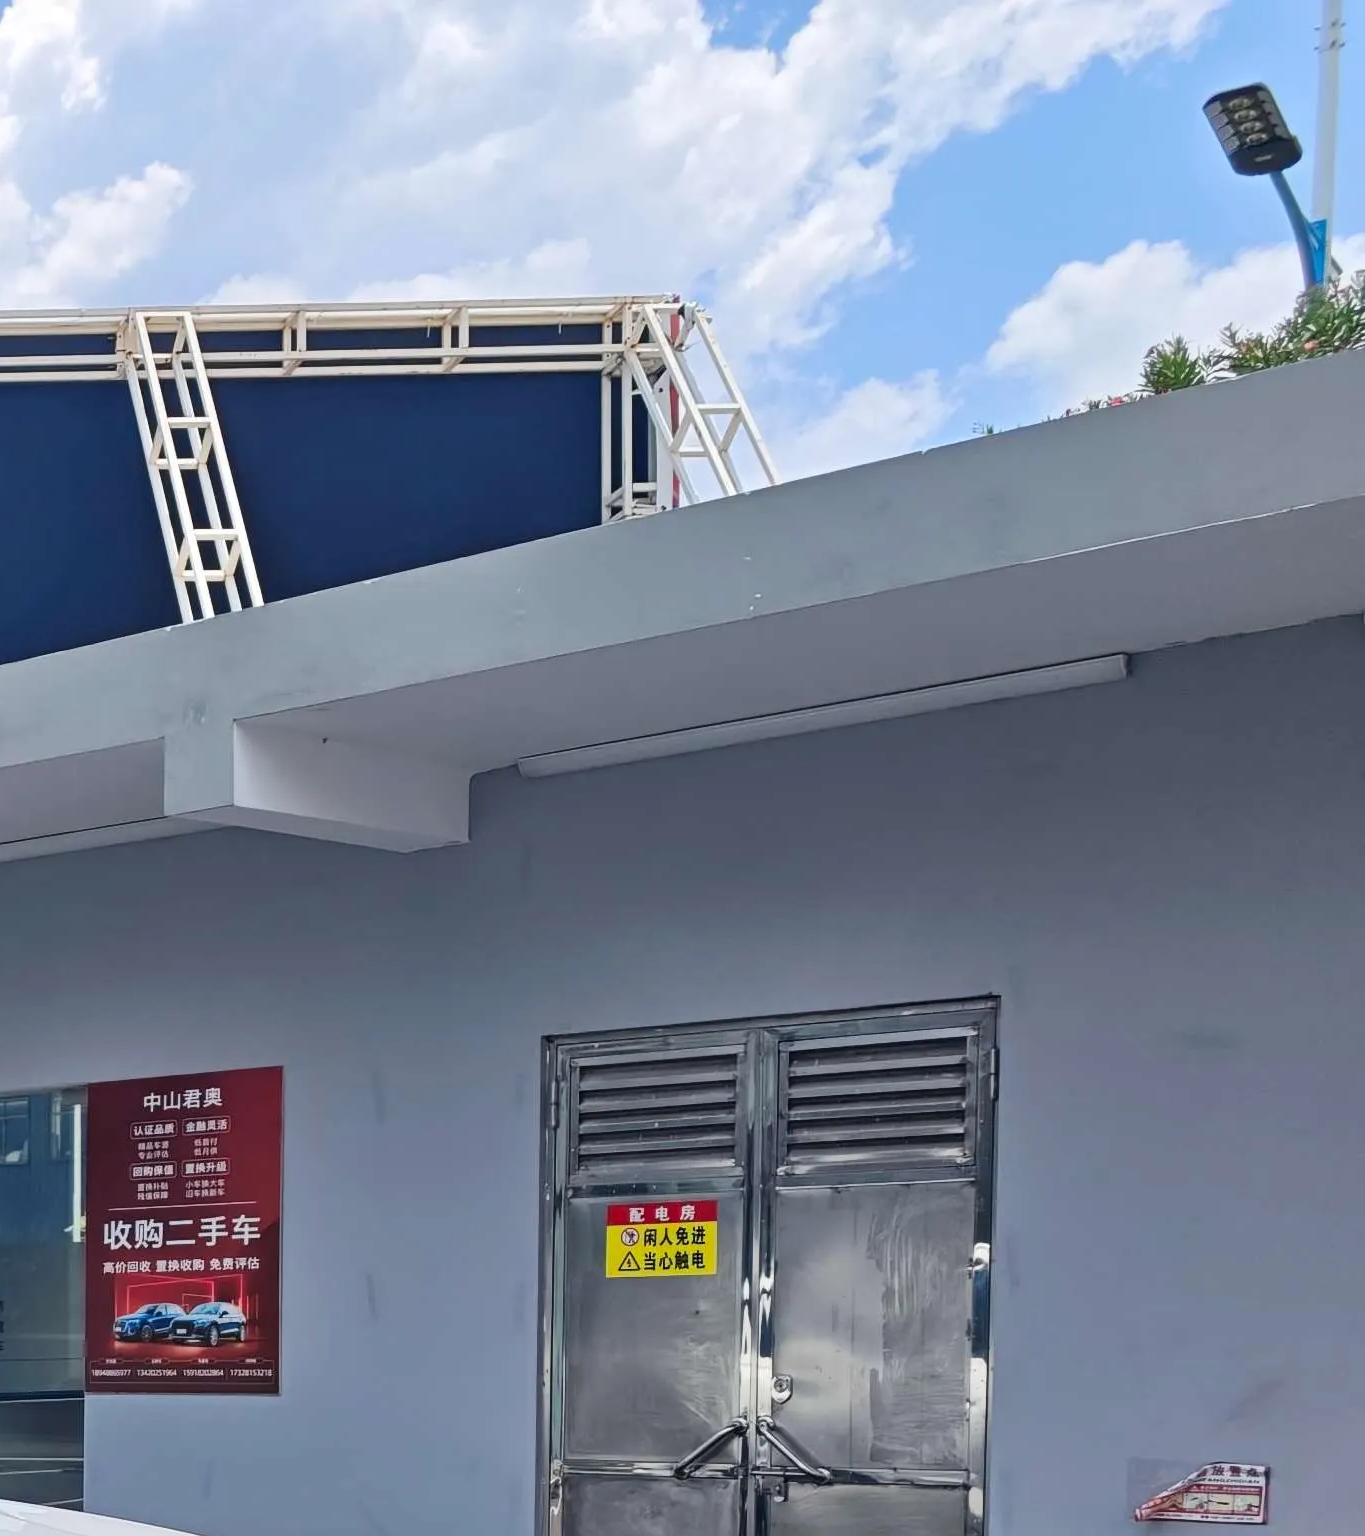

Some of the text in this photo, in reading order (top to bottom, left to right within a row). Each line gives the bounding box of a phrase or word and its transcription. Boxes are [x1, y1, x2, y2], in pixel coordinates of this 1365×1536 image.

[133, 1122, 175, 1136] 认证品质
[185, 1119, 228, 1133] 金融灵活
[185, 1161, 227, 1175] 置换升级
[629, 1205, 696, 1223] 配电房
[103, 1214, 261, 1250] 收购二手车
[644, 1226, 706, 1247] 闲人免进
[103, 1256, 260, 1275] 高价回收 置换收购 免费评估
[644, 1250, 706, 1271] 当心触电
